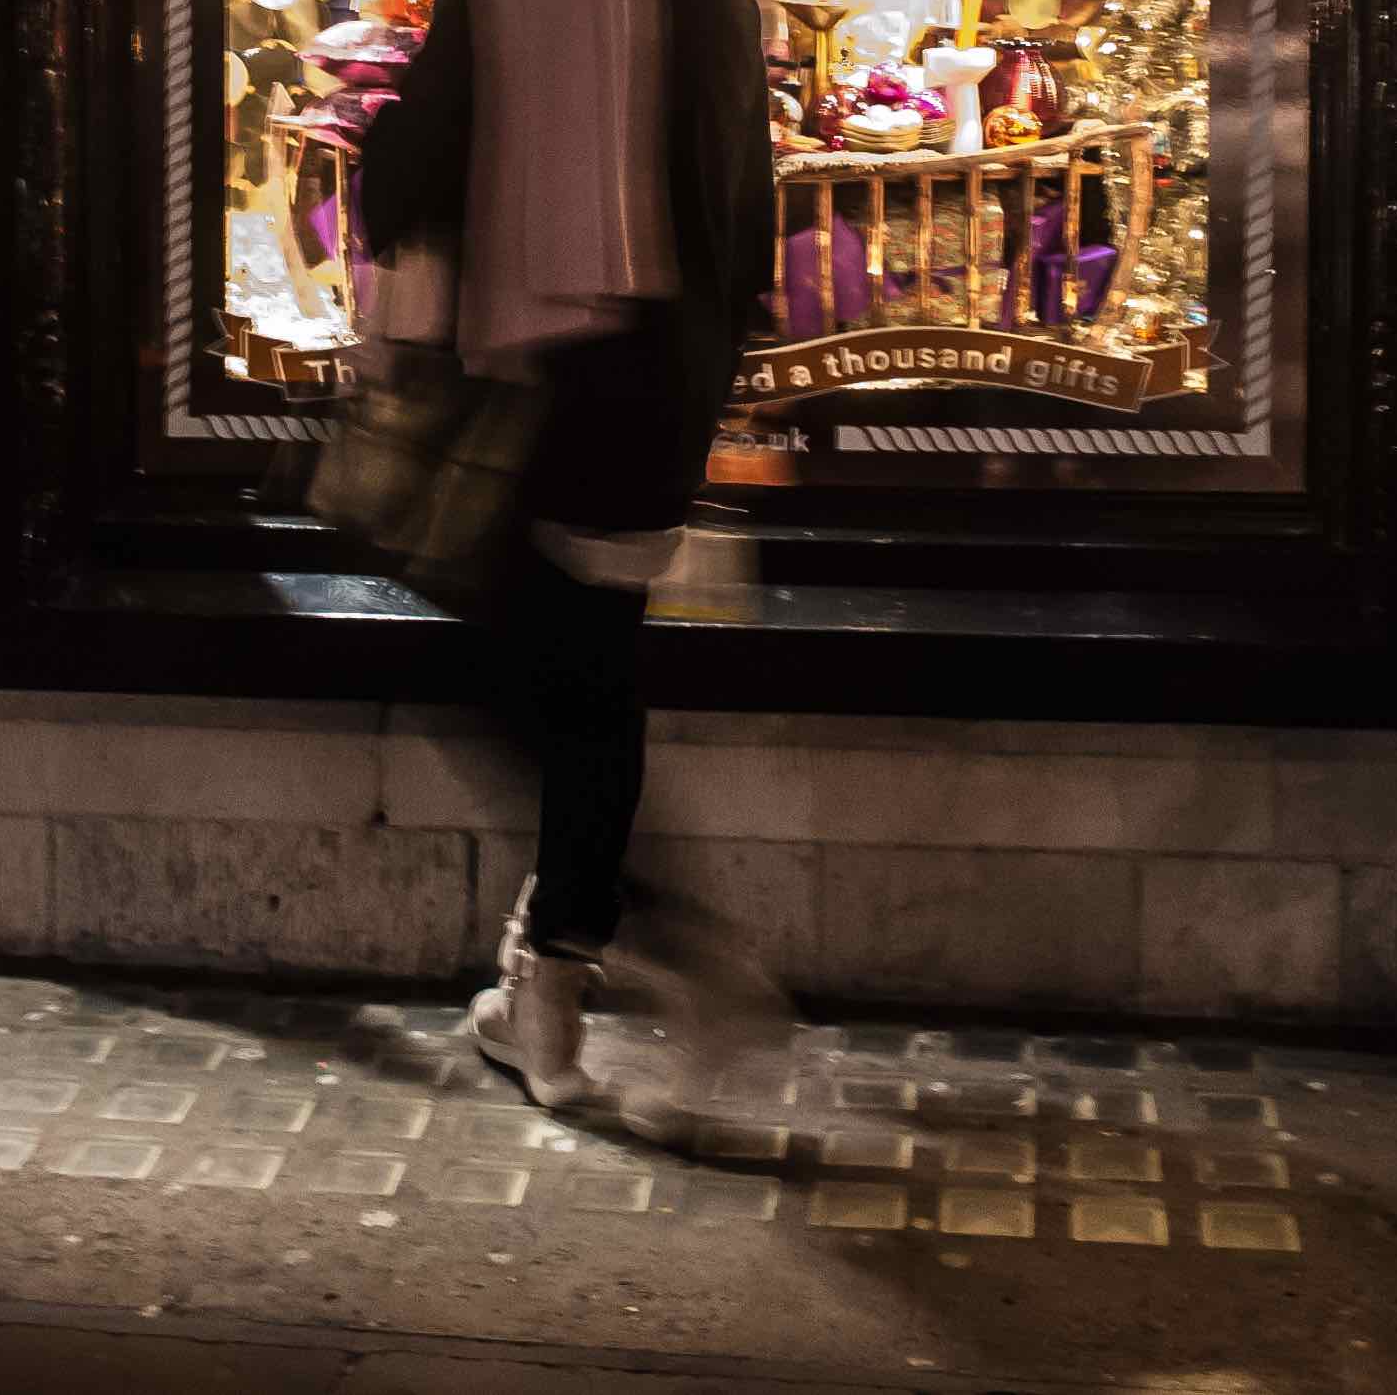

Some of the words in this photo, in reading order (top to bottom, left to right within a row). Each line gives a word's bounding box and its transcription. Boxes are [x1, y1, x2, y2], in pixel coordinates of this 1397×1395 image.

[302, 357, 358, 387] Th
[789, 365, 813, 387] a
[822, 346, 1012, 377] thousand
[1025, 355, 1119, 396] gifts
